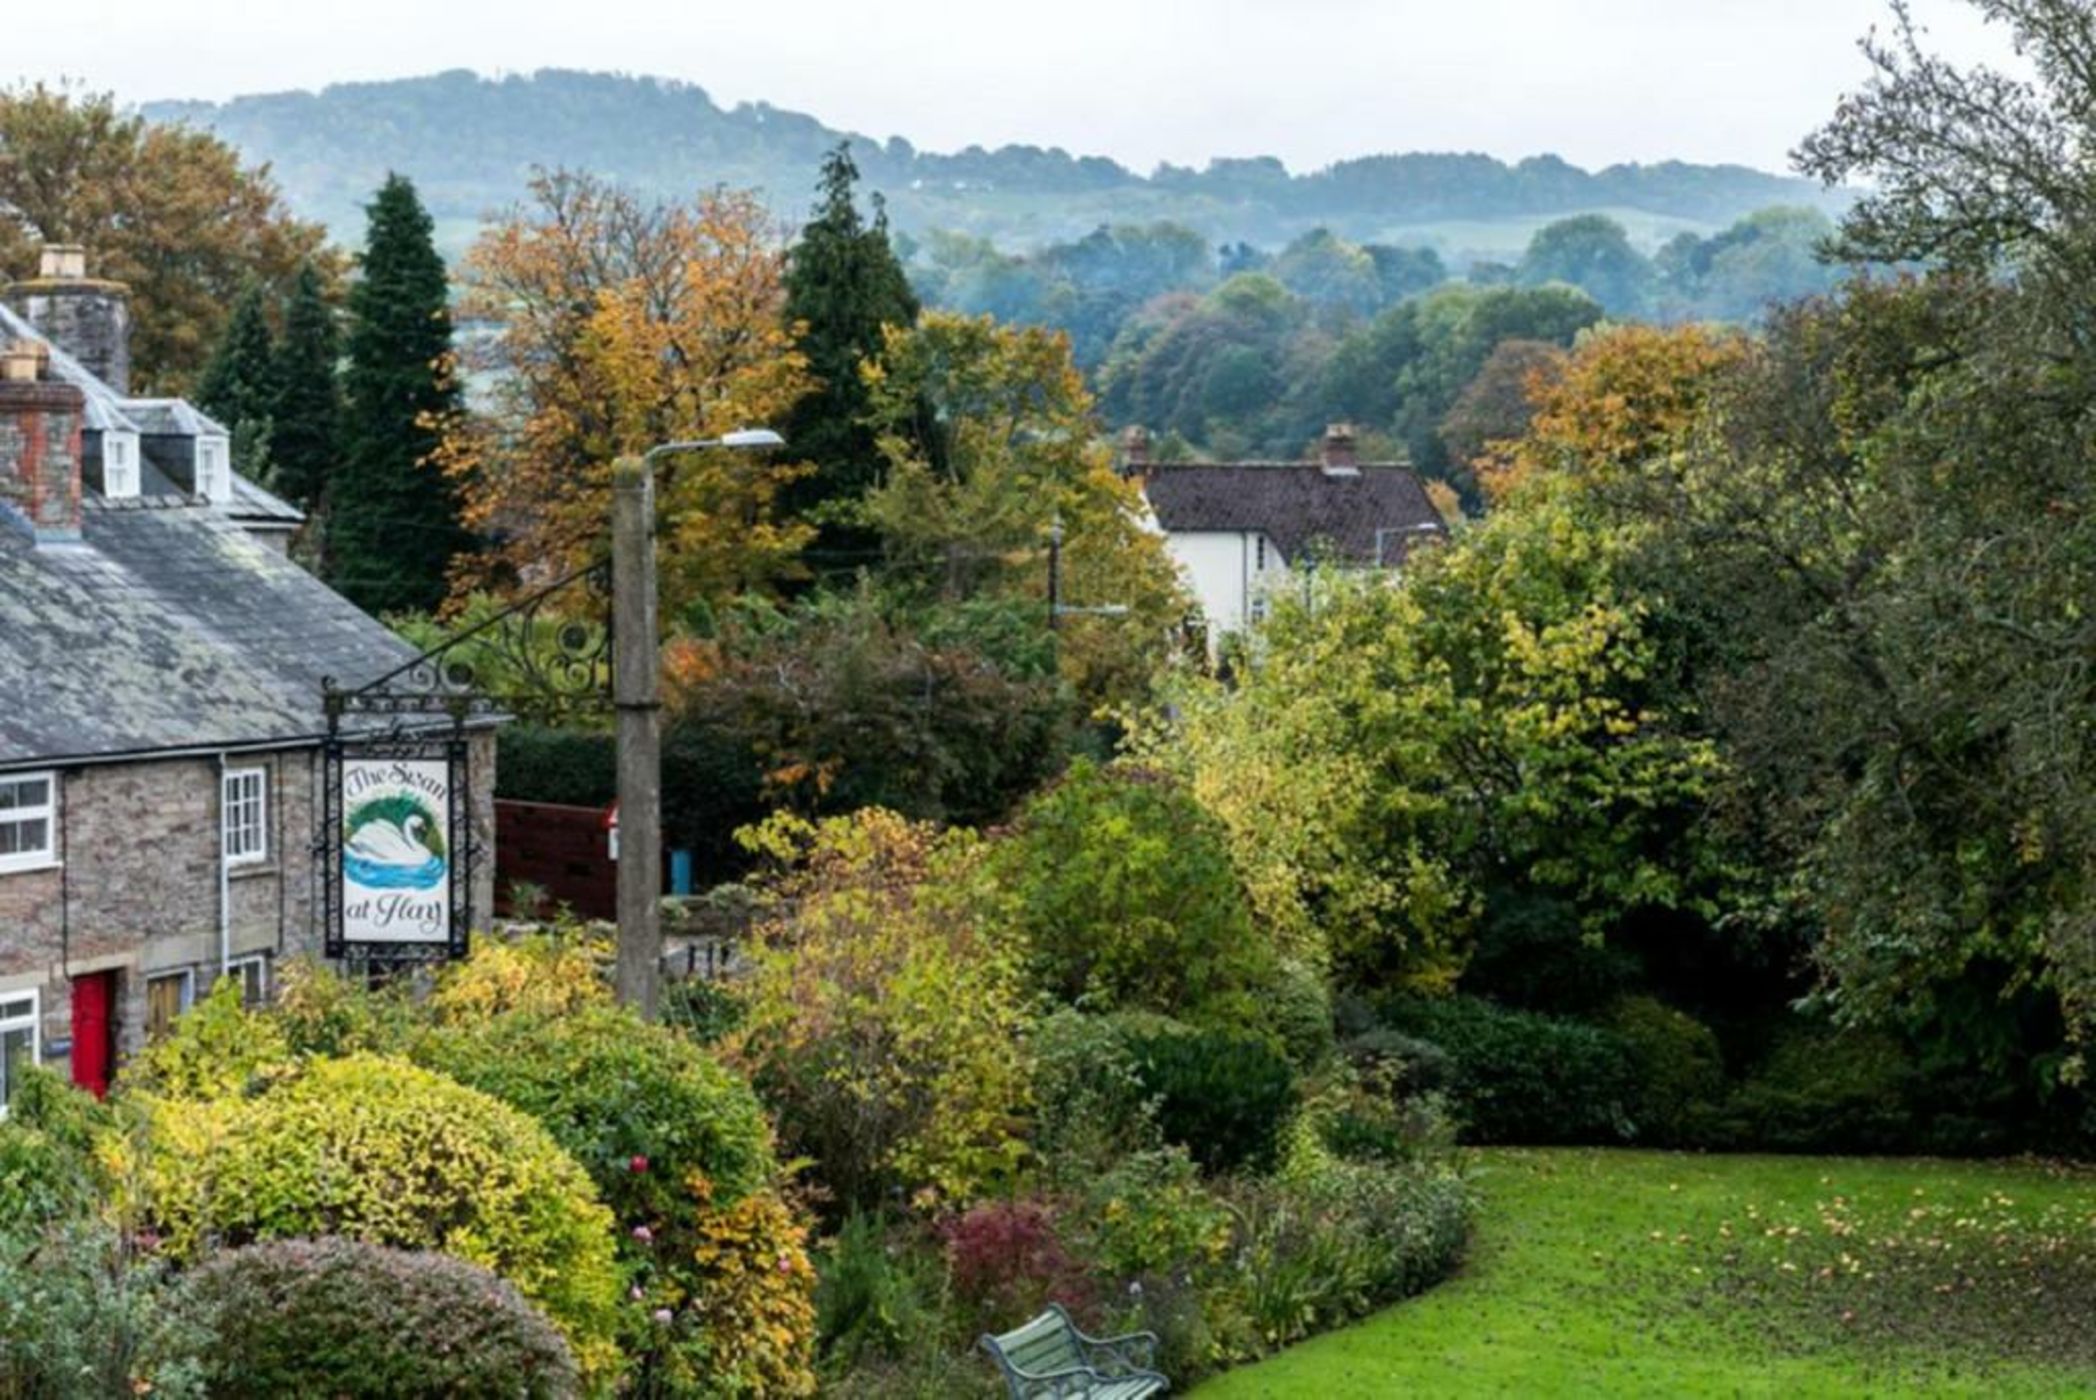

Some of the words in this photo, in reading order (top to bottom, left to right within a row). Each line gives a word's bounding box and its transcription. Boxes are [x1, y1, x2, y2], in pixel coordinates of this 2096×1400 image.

[347, 766, 386, 797] The
[389, 763, 447, 800] Swan
[346, 901, 370, 919] at
[374, 894, 442, 934] Hay
